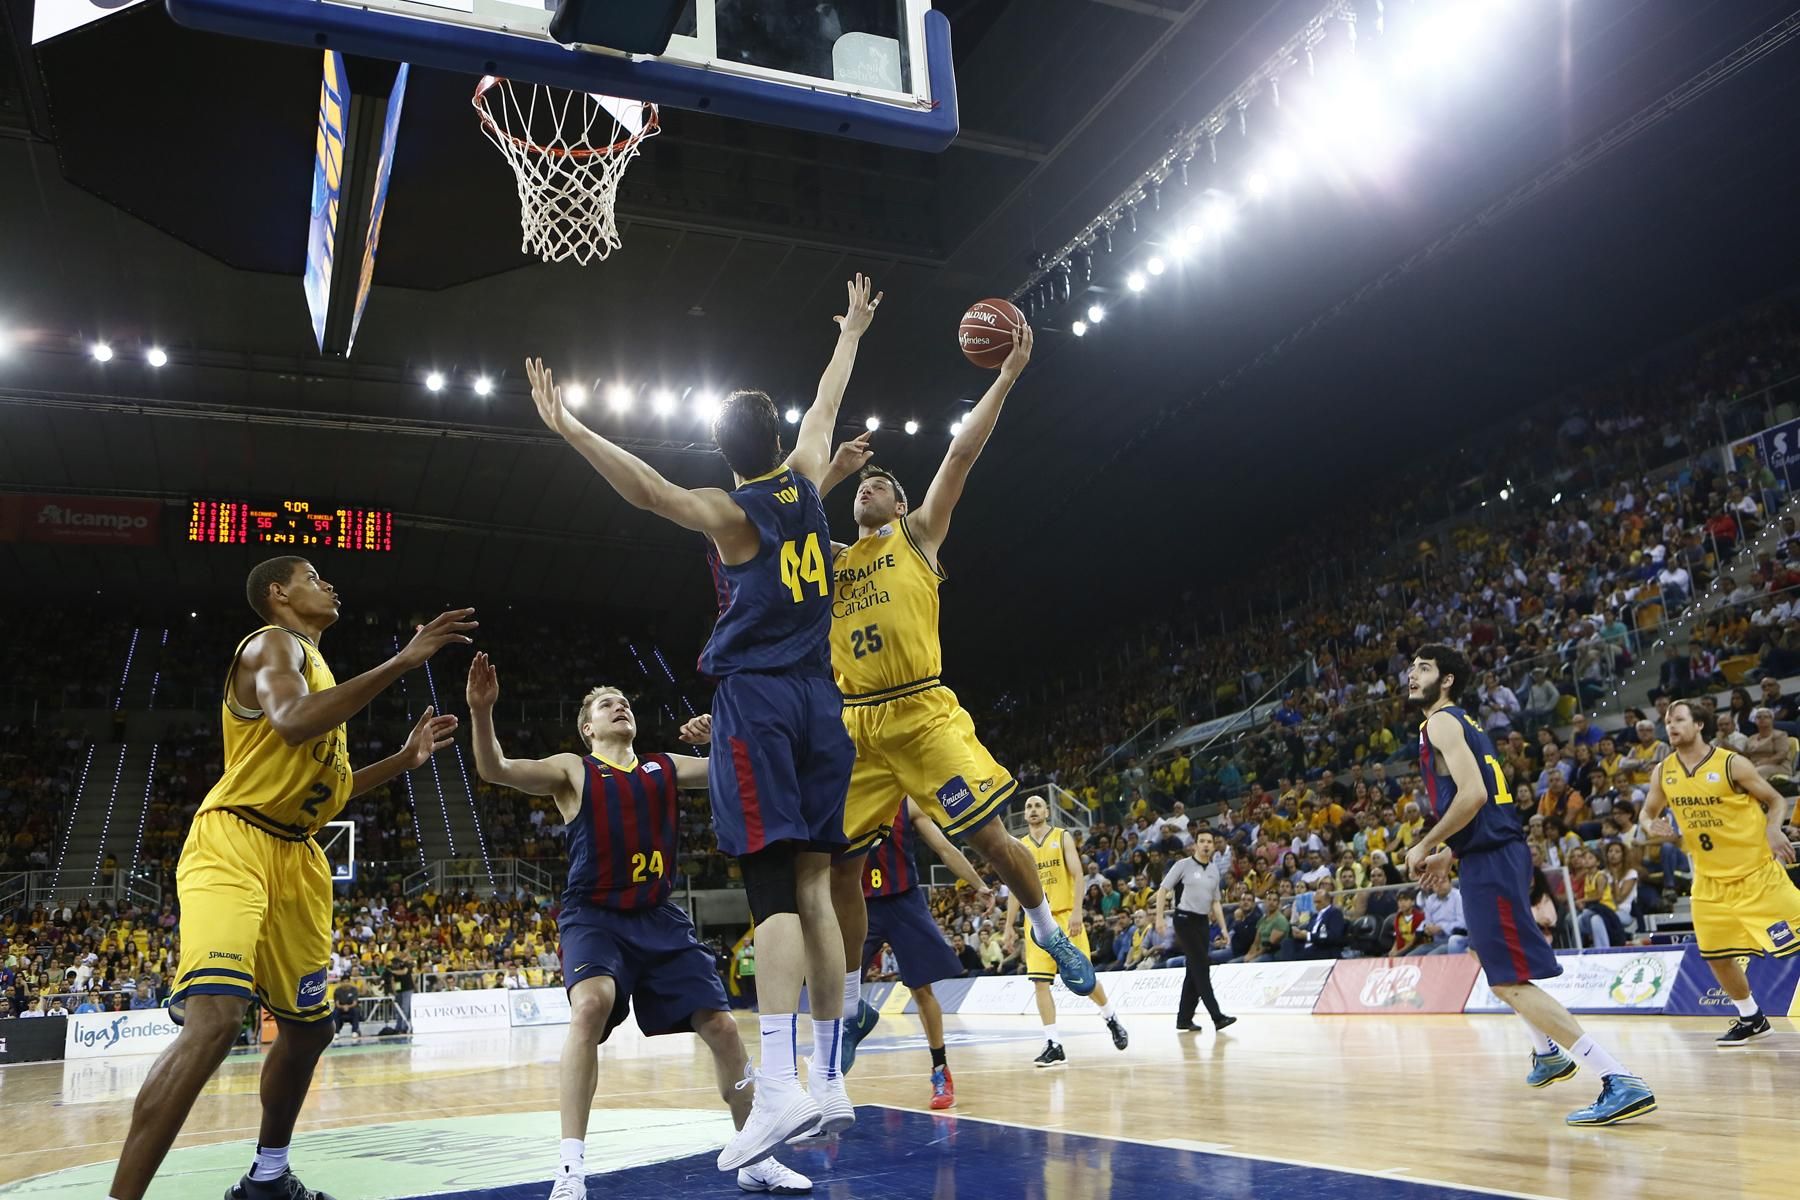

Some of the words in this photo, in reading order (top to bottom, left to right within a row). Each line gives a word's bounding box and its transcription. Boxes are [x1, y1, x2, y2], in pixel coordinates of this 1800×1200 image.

[961, 311, 997, 327] ALDING
[284, 501, 309, 513] 9:09
[38, 504, 148, 530] Alcampo
[257, 517, 272, 528] 56
[314, 520, 329, 532] 59
[273, 533, 287, 543] 24
[778, 532, 829, 604] 44
[834, 553, 896, 584] ERBALIFE
[840, 580, 877, 601] Gran
[832, 589, 890, 619] Canaria
[851, 624, 884, 660] 25
[1682, 807, 1711, 819] Gran
[1687, 818, 1723, 829] anaria
[1699, 833, 1713, 851] 8
[631, 850, 664, 883] 24
[871, 868, 882, 889] 8
[208, 951, 242, 962] SPALDING
[434, 1002, 507, 1018] PROVINCIA
[74, 1021, 110, 1047] liga
[120, 1021, 179, 1038] endesa
